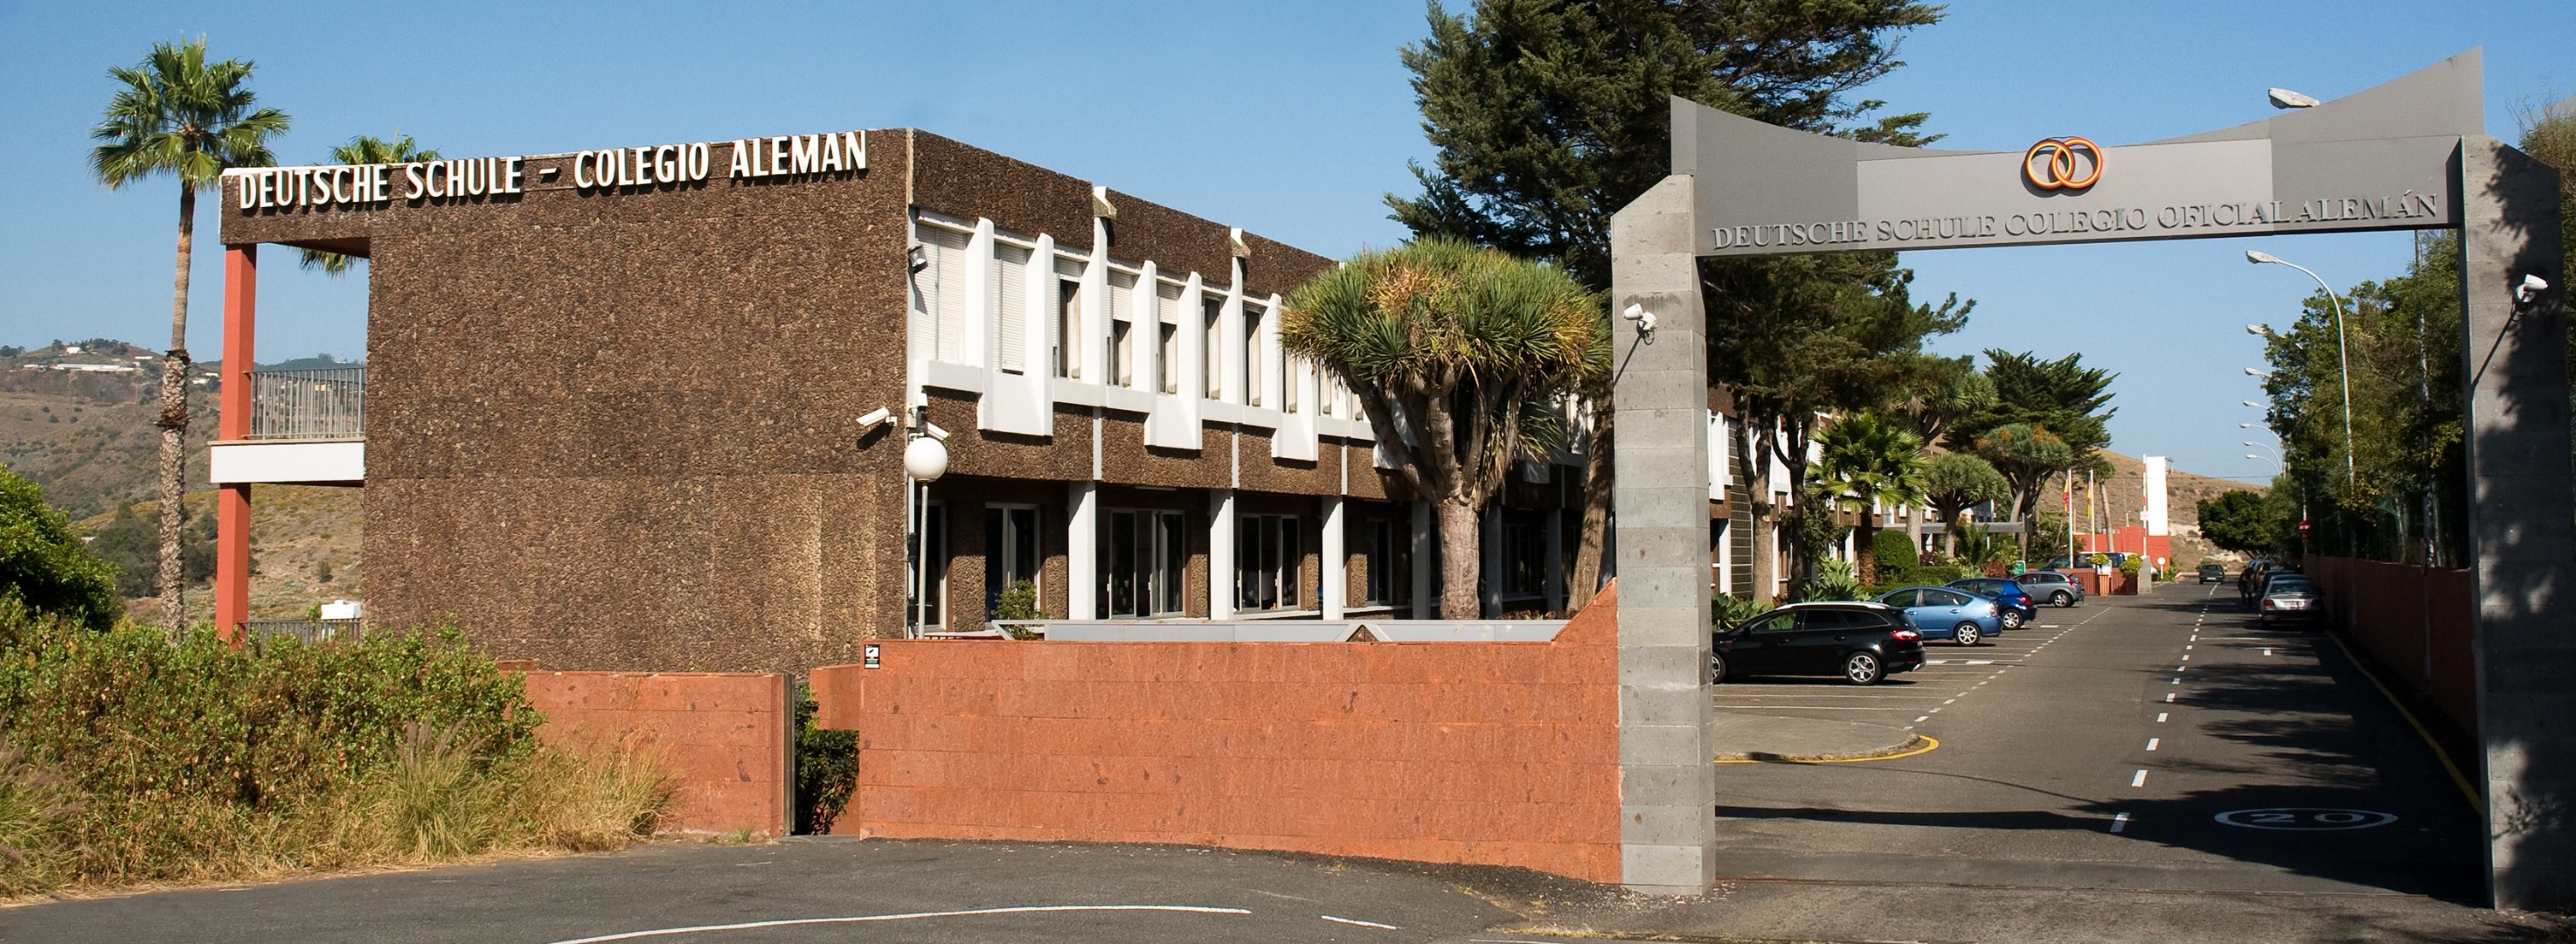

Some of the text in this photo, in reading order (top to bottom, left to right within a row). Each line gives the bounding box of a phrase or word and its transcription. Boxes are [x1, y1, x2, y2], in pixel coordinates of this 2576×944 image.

[239, 165, 387, 210] DEUTSCHE
[405, 156, 522, 200] SCHULE
[573, 142, 711, 189] COLEGIO
[729, 130, 869, 178] ALEMAN
[1712, 189, 2439, 250] DEUTSCHE SCHULE COLEGIO OFICIAL ALEMÁN
[2250, 813, 2364, 823] 20
